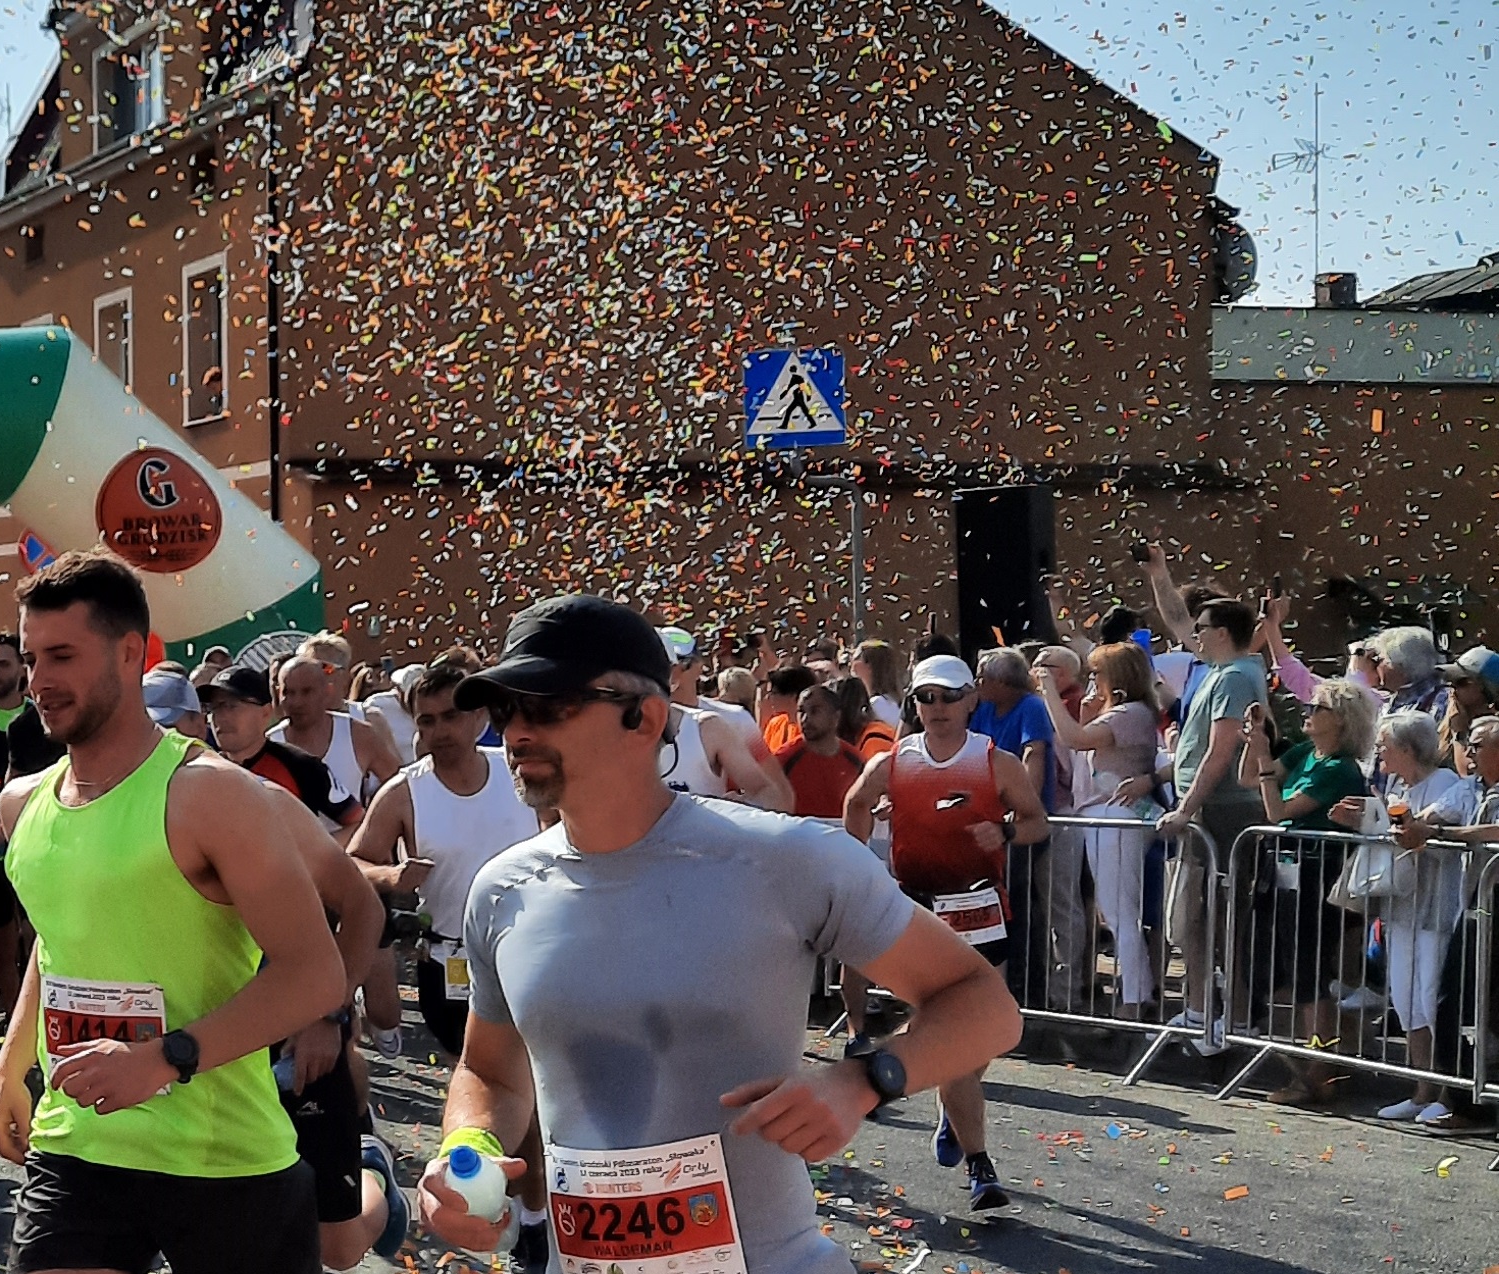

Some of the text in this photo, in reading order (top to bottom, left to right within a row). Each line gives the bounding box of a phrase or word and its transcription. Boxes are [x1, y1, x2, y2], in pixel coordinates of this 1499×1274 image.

[137, 458, 180, 509] G
[122, 513, 203, 531] BROWAR
[117, 529, 207, 546] GRODZISK
[64, 1014, 132, 1043] 1414
[577, 1196, 685, 1243] 2246
[594, 1240, 674, 1258] WALDEMAR
